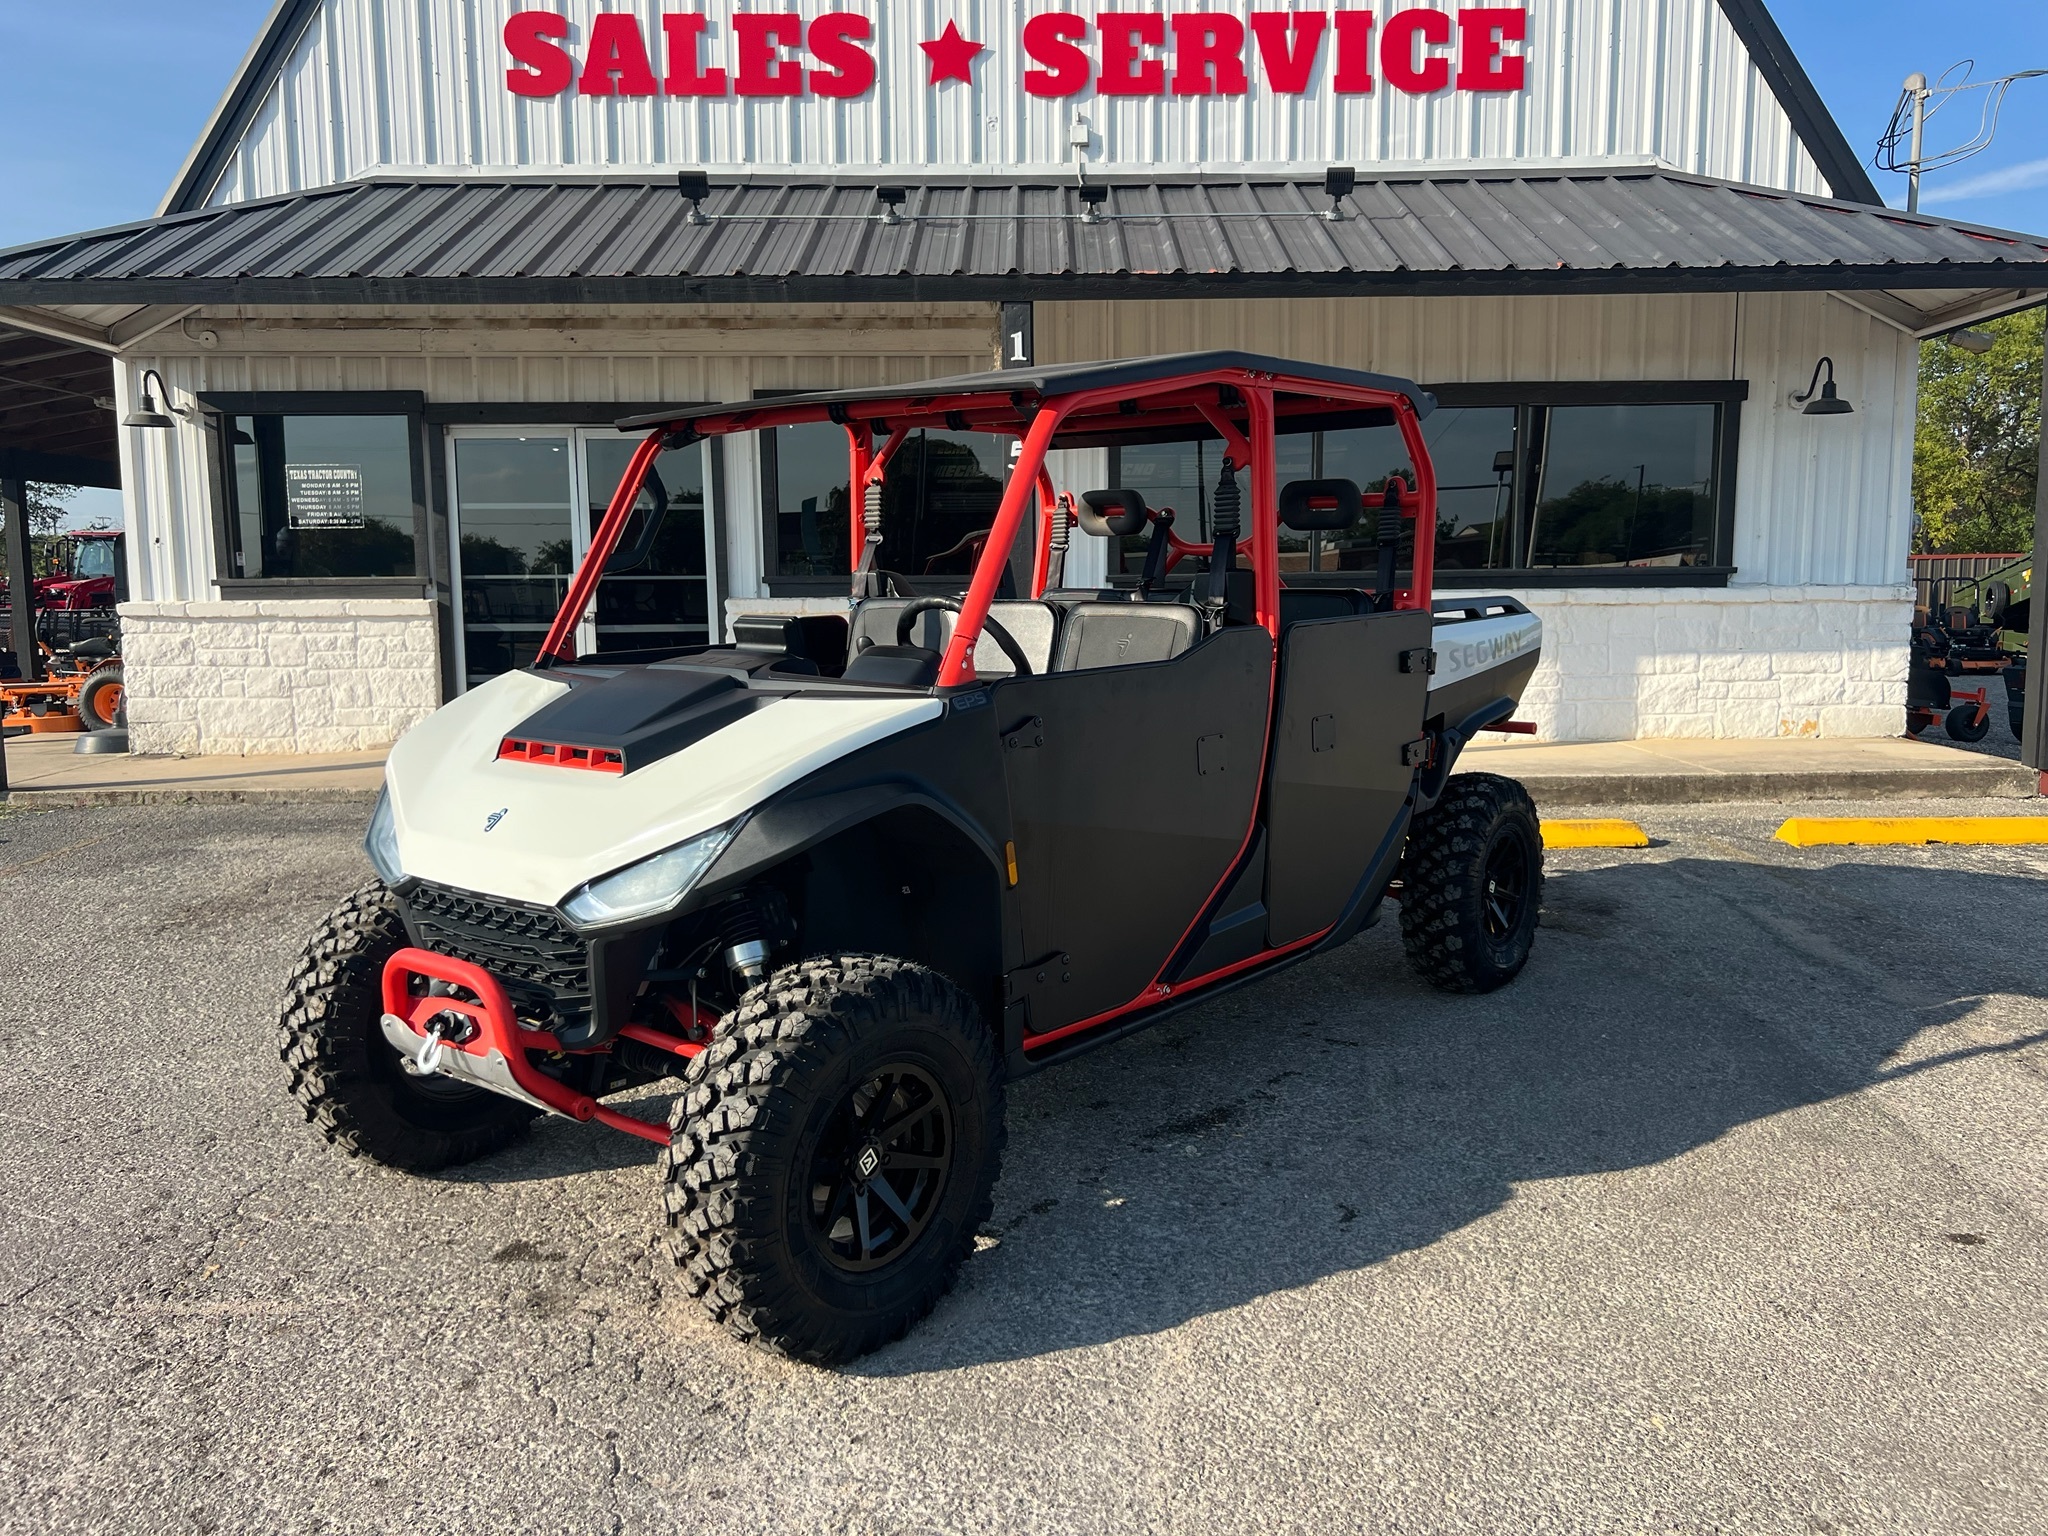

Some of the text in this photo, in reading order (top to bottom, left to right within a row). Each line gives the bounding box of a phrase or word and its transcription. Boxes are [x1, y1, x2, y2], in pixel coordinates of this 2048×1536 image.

[503, 8, 1526, 98] SALES SERVICE
[1010, 331, 1027, 361] 1
[289, 469, 358, 480] TEXAS TRACTOR COUNTRY
[1448, 630, 1522, 673] SEGWAY
[953, 691, 987, 710] EPS
